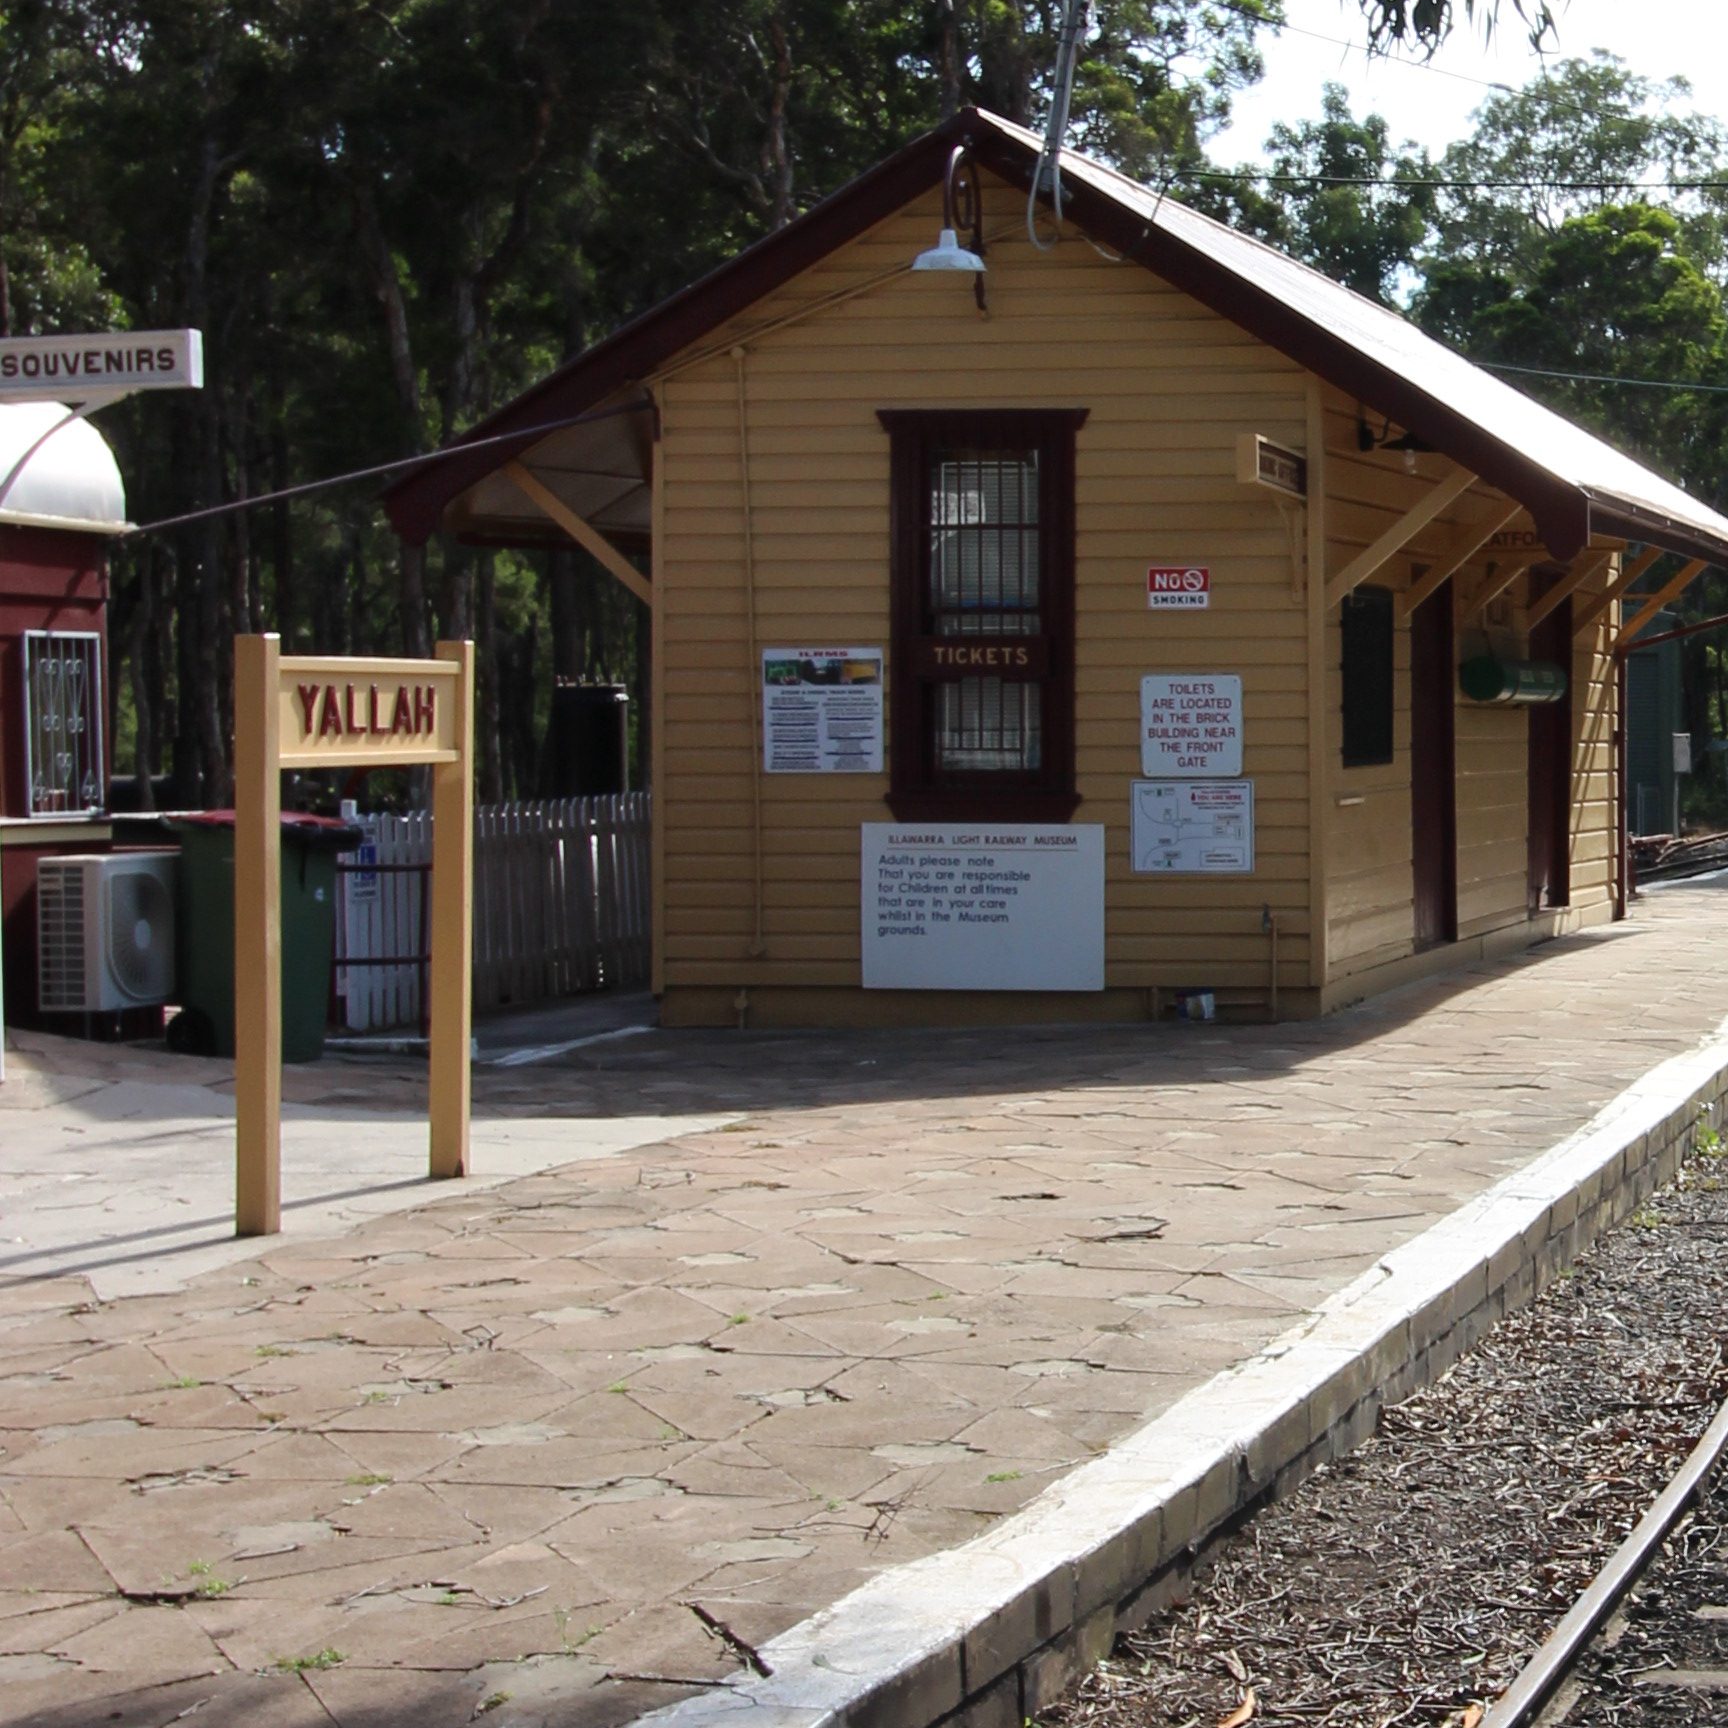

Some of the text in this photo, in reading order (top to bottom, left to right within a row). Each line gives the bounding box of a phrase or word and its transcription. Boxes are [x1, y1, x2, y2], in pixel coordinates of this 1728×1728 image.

[1, 348, 176, 378] SOUVENIRS
[1155, 572, 1181, 590] NO
[1152, 595, 1204, 605] SMOKING
[933, 647, 1028, 665] TICKETS
[1168, 683, 1215, 695] TOILETS
[297, 682, 435, 736] YALLAH
[1151, 698, 1232, 709] ARE LOCATED
[1152, 713, 1230, 724] IN THE BRICK
[1148, 727, 1236, 738] BUILDING NEAR
[1160, 742, 1224, 753] THE FRONT
[1177, 756, 1208, 767] GATE
[888, 835, 1077, 845] ILLAWARRA LIGHT RAILWAY MUSEUM
[878, 855, 995, 867] Adults please note
[878, 868, 1031, 882] That you are responsible
[878, 882, 1018, 895] for Children at all times
[878, 896, 1007, 910] that are in your care
[878, 910, 1009, 923] whilst in the Museum
[878, 924, 927, 937] grounds.
